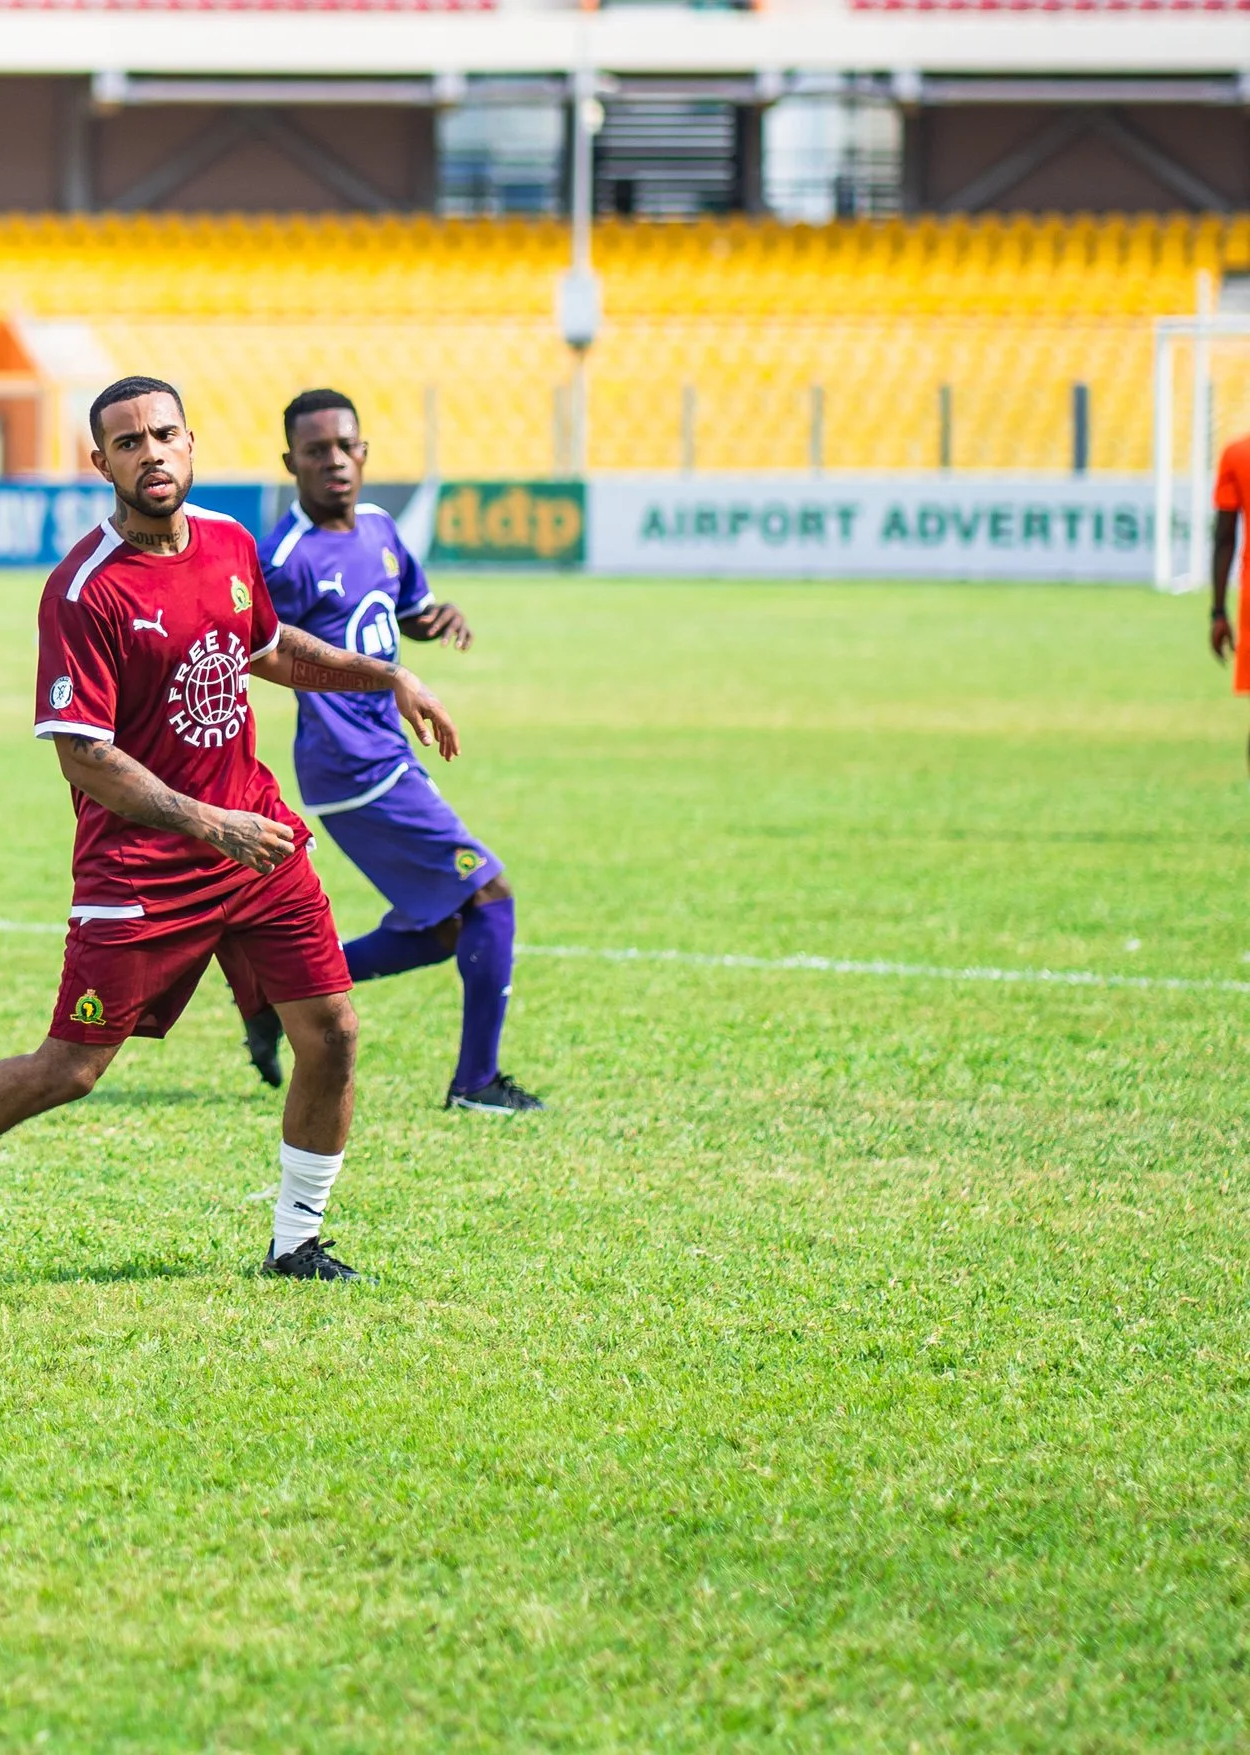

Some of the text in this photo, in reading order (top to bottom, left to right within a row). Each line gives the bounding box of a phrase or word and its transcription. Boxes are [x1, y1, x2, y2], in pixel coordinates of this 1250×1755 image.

[53, 490, 115, 556] S
[438, 486, 581, 558] ddp
[638, 501, 1214, 550] AIRPORT ADVERTIS
[168, 629, 250, 748] FREE THE YOUTH
